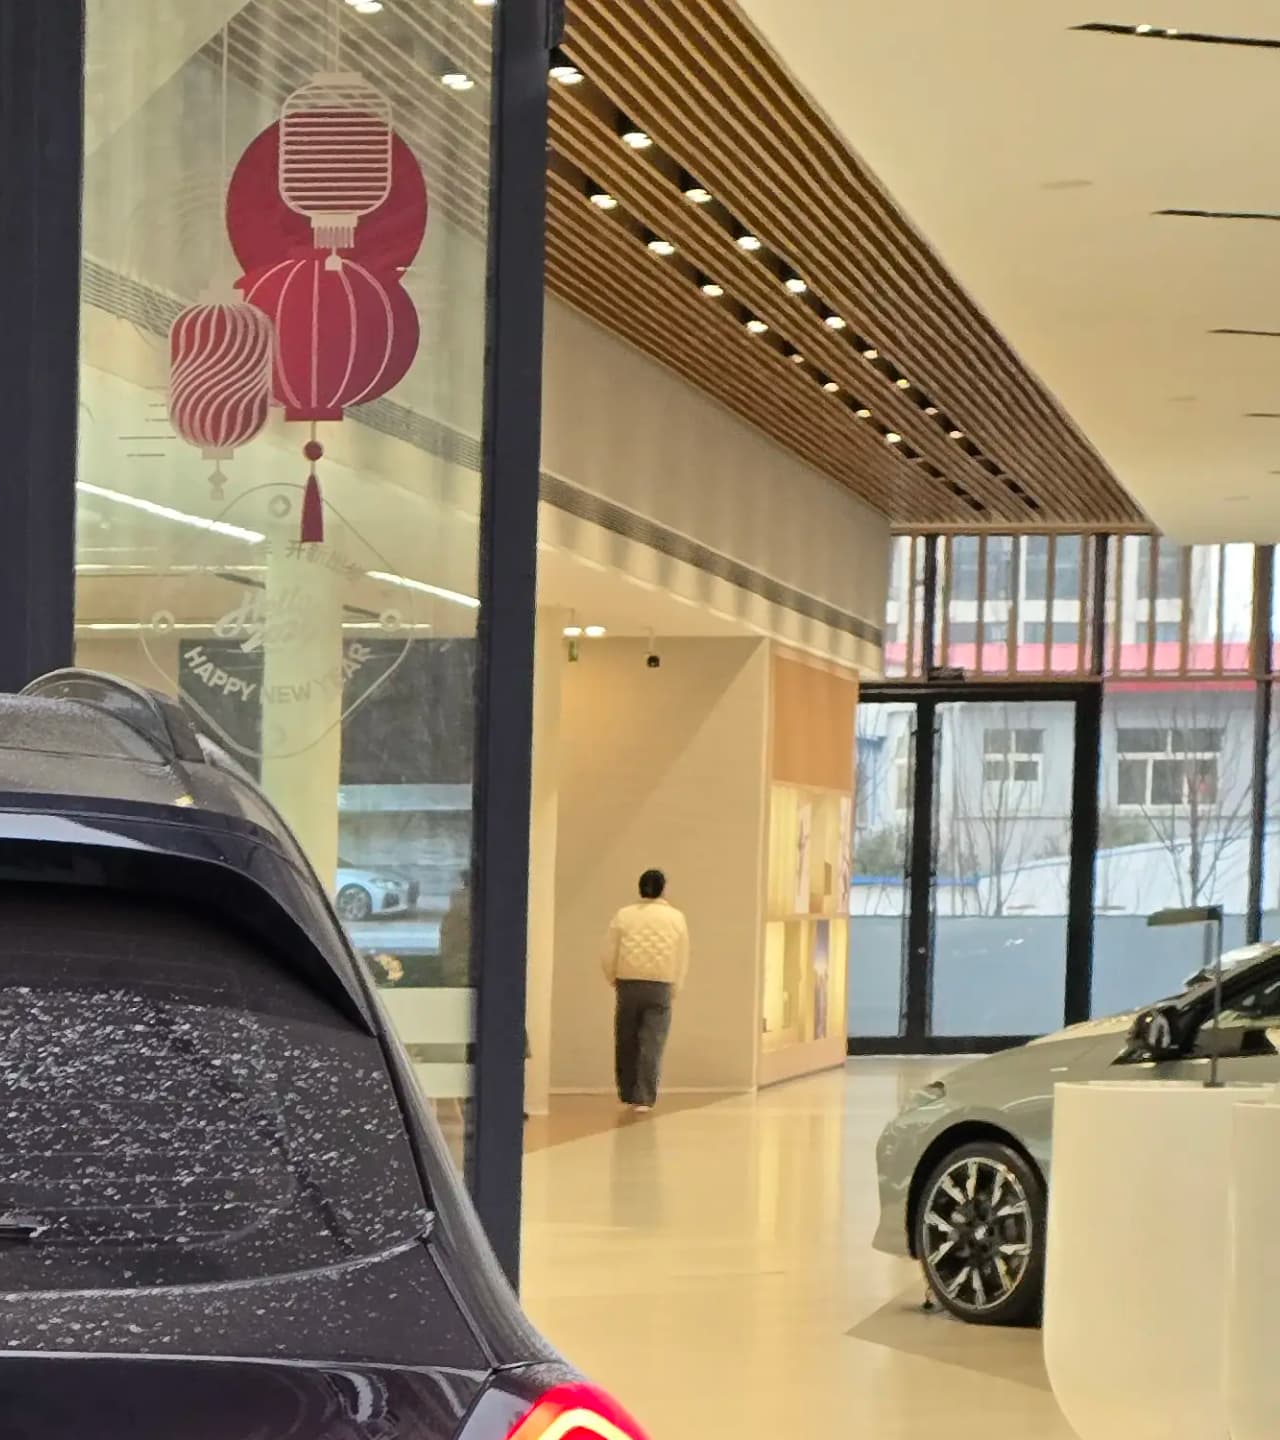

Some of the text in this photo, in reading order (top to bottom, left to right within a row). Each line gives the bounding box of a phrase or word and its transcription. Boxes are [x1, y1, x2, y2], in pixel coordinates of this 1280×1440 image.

[183, 642, 372, 704] HAPPY NEW YEAR
